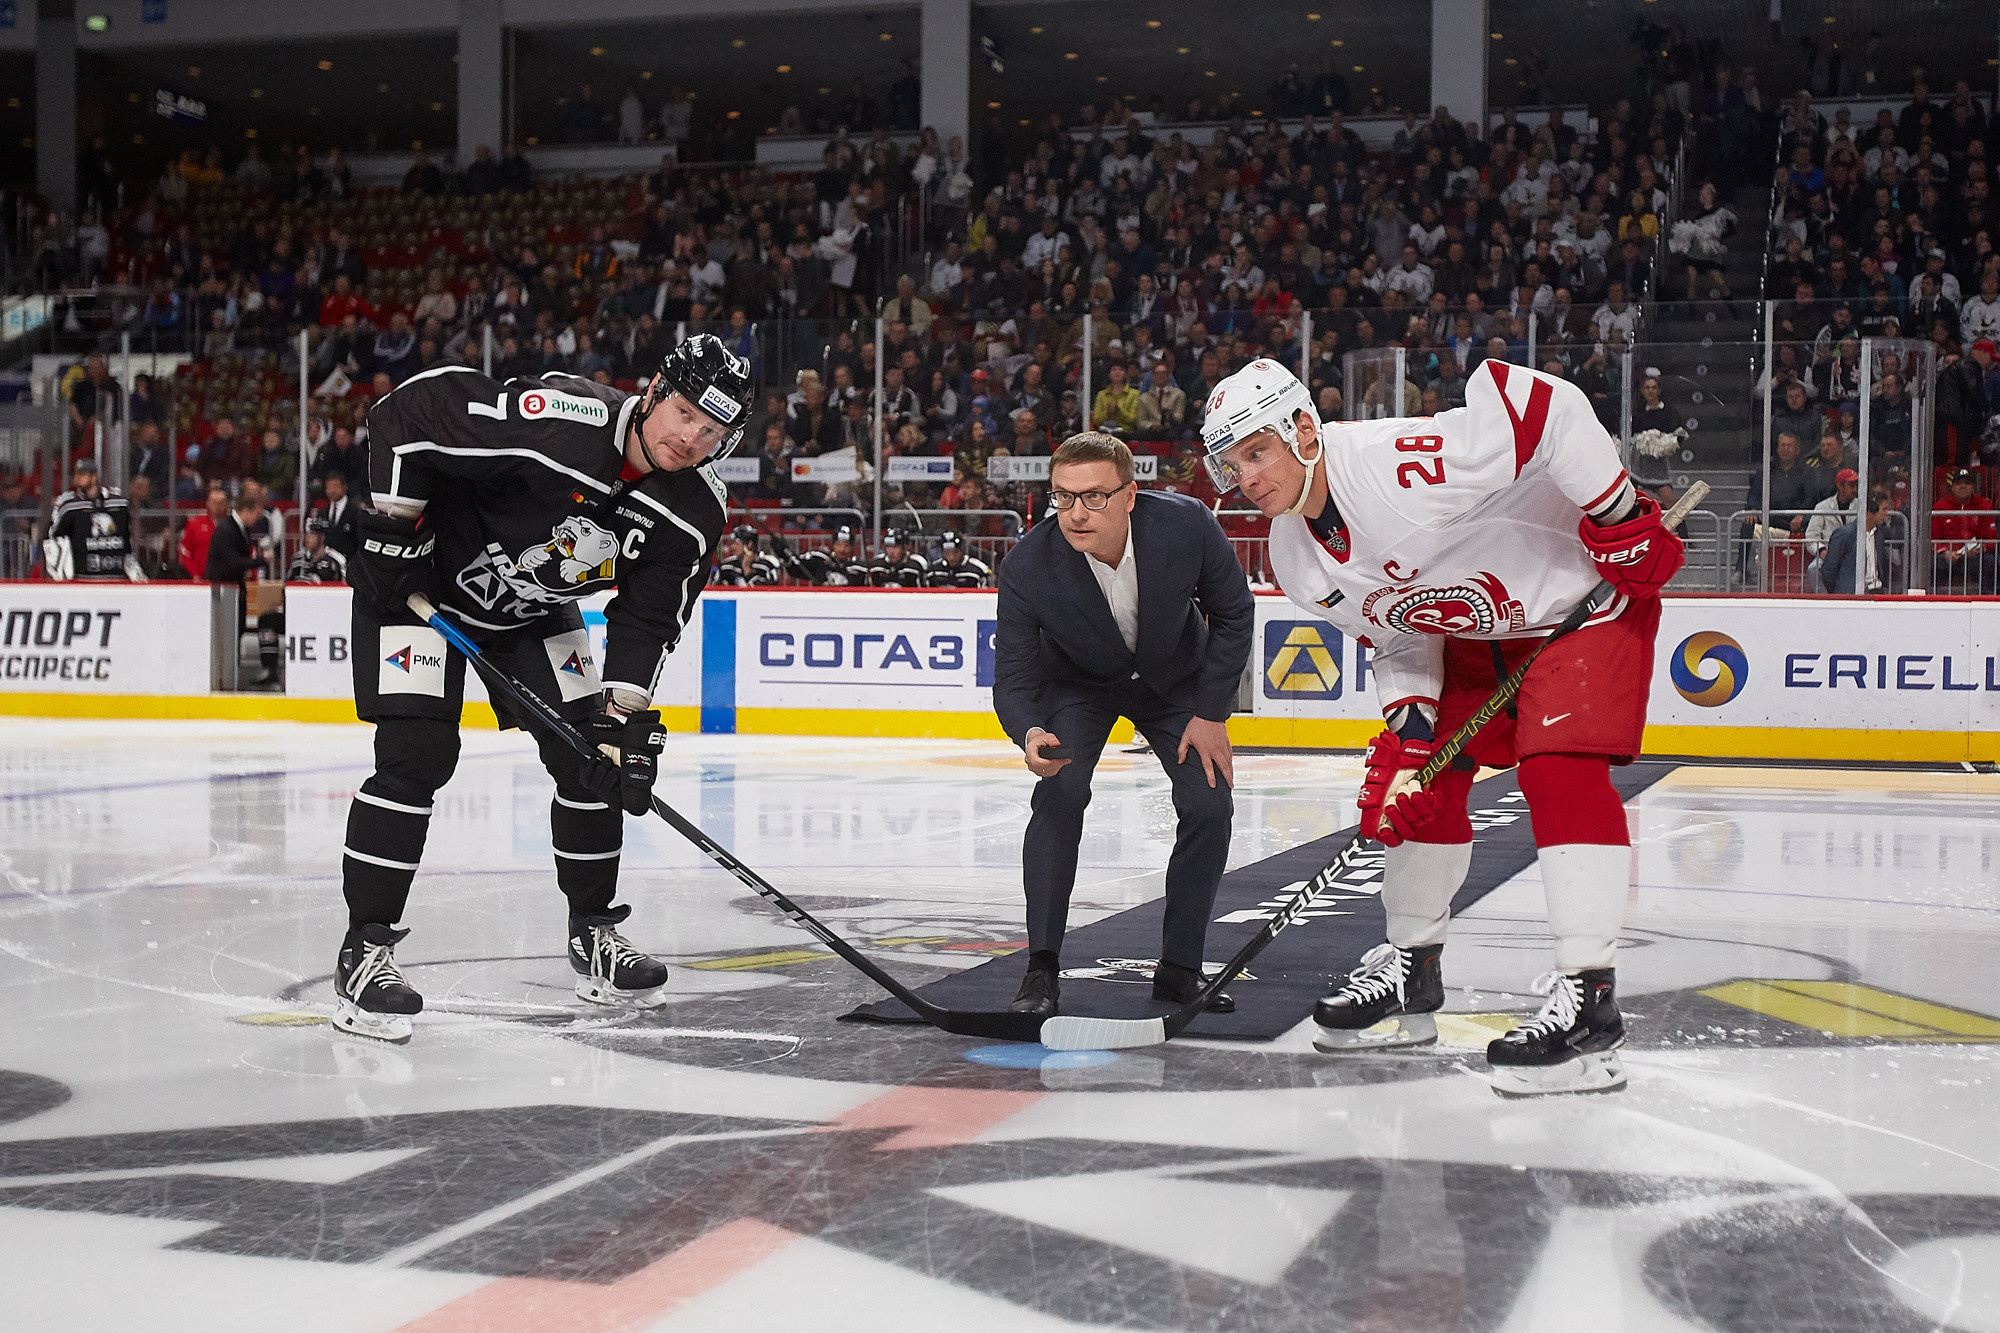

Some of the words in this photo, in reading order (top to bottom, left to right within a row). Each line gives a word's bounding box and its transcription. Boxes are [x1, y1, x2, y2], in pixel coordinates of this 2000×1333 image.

[467, 392, 507, 421] 7
[550, 396, 605, 420] ариант
[706, 389, 737, 415] СОГАЗ
[1205, 390, 1226, 416] 28
[1205, 423, 1232, 444] СОГАЗ
[1012, 462, 1050, 475] ЧТП
[1395, 434, 1447, 489] 28
[364, 534, 434, 559] BAUE
[621, 528, 646, 560] C
[1584, 538, 1651, 564] UER
[1383, 559, 1419, 582] C
[0, 610, 121, 648] ПОРТ
[413, 654, 441, 668] РМК
[759, 632, 964, 670] СОГАЗ
[0, 655, 112, 682] СПРЕСС
[1785, 653, 2000, 692] ERIELL
[511, 675, 562, 721] TRUE
[1404, 746, 1432, 756] BAUER
[698, 838, 836, 946] TRUE
[1268, 838, 1363, 938] BAUER
